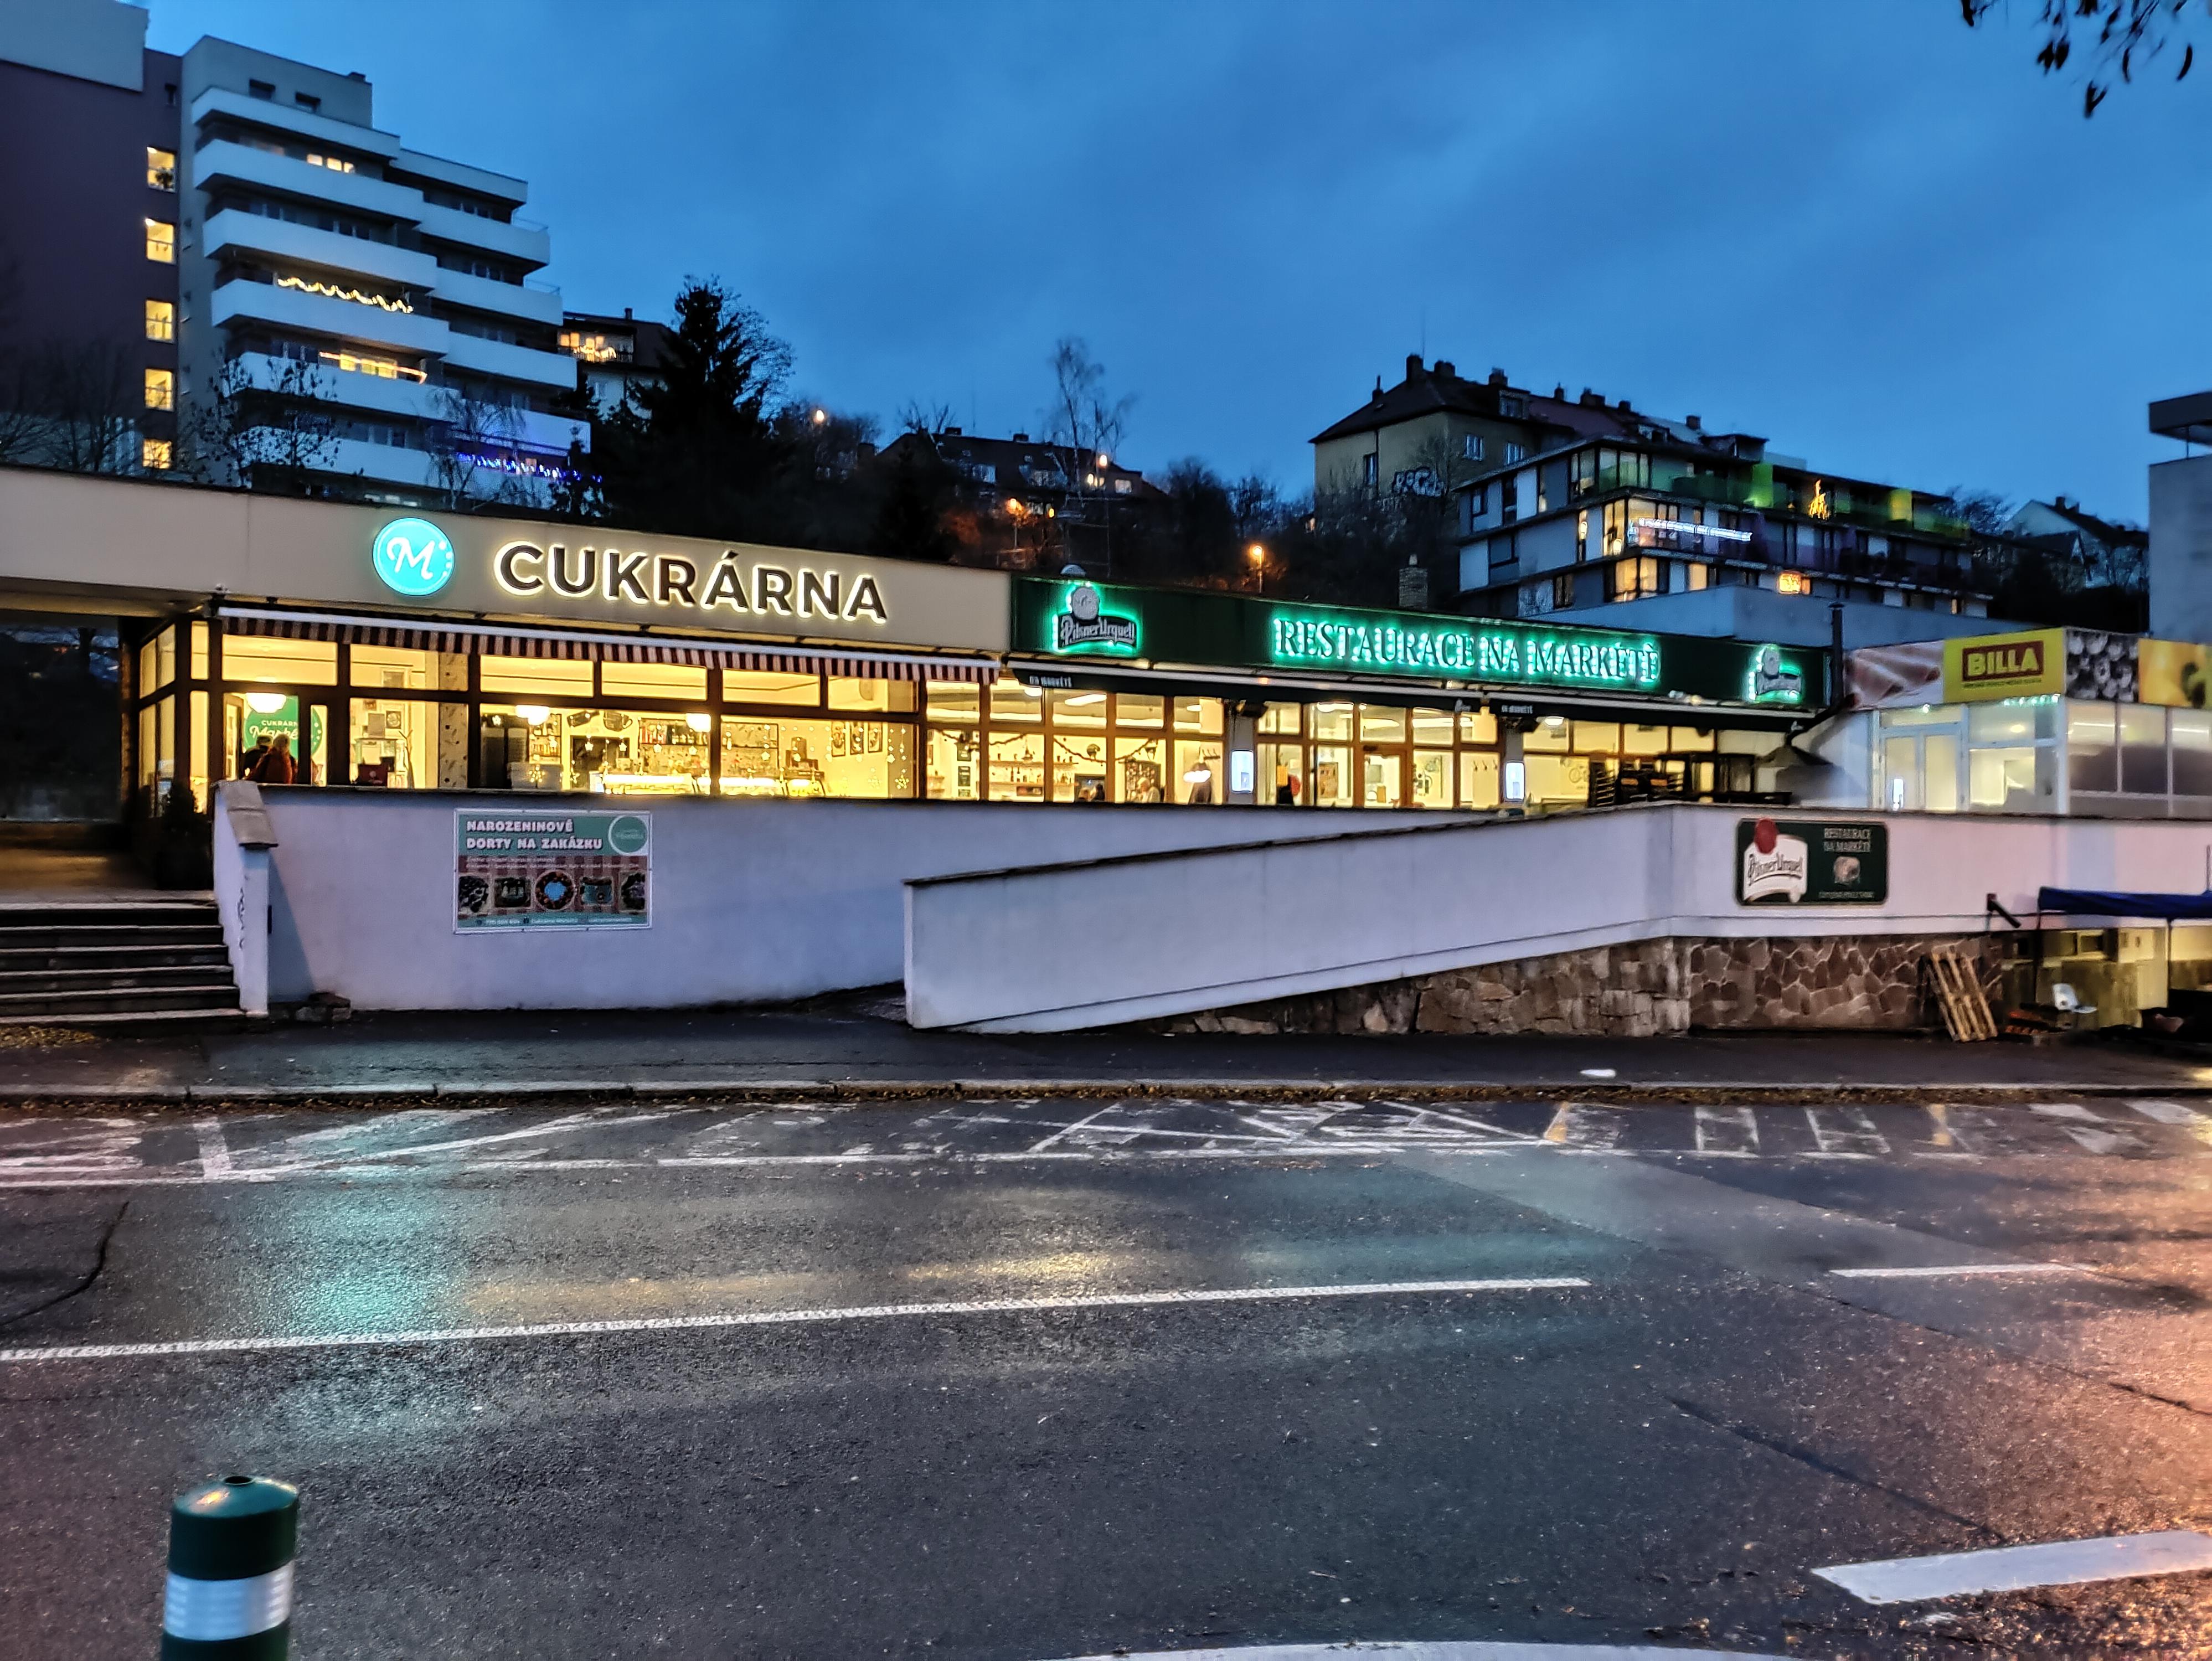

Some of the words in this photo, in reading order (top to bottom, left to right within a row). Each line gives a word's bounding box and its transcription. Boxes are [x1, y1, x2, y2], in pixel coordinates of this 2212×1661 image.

[386, 537, 435, 580] M
[498, 543, 888, 622] CUKRÁRNA
[1060, 615, 1099, 646] Pilsner
[1098, 617, 1135, 642] Urquell
[1273, 618, 1474, 668] RESTAURACE
[1479, 636, 1520, 673] NA
[1967, 647, 2039, 676] BILLA
[467, 819, 574, 832] NAROZENINOVÉ
[467, 838, 512, 849] DORTY
[518, 838, 536, 849] NA
[542, 835, 603, 849] ZAKÁZKU
